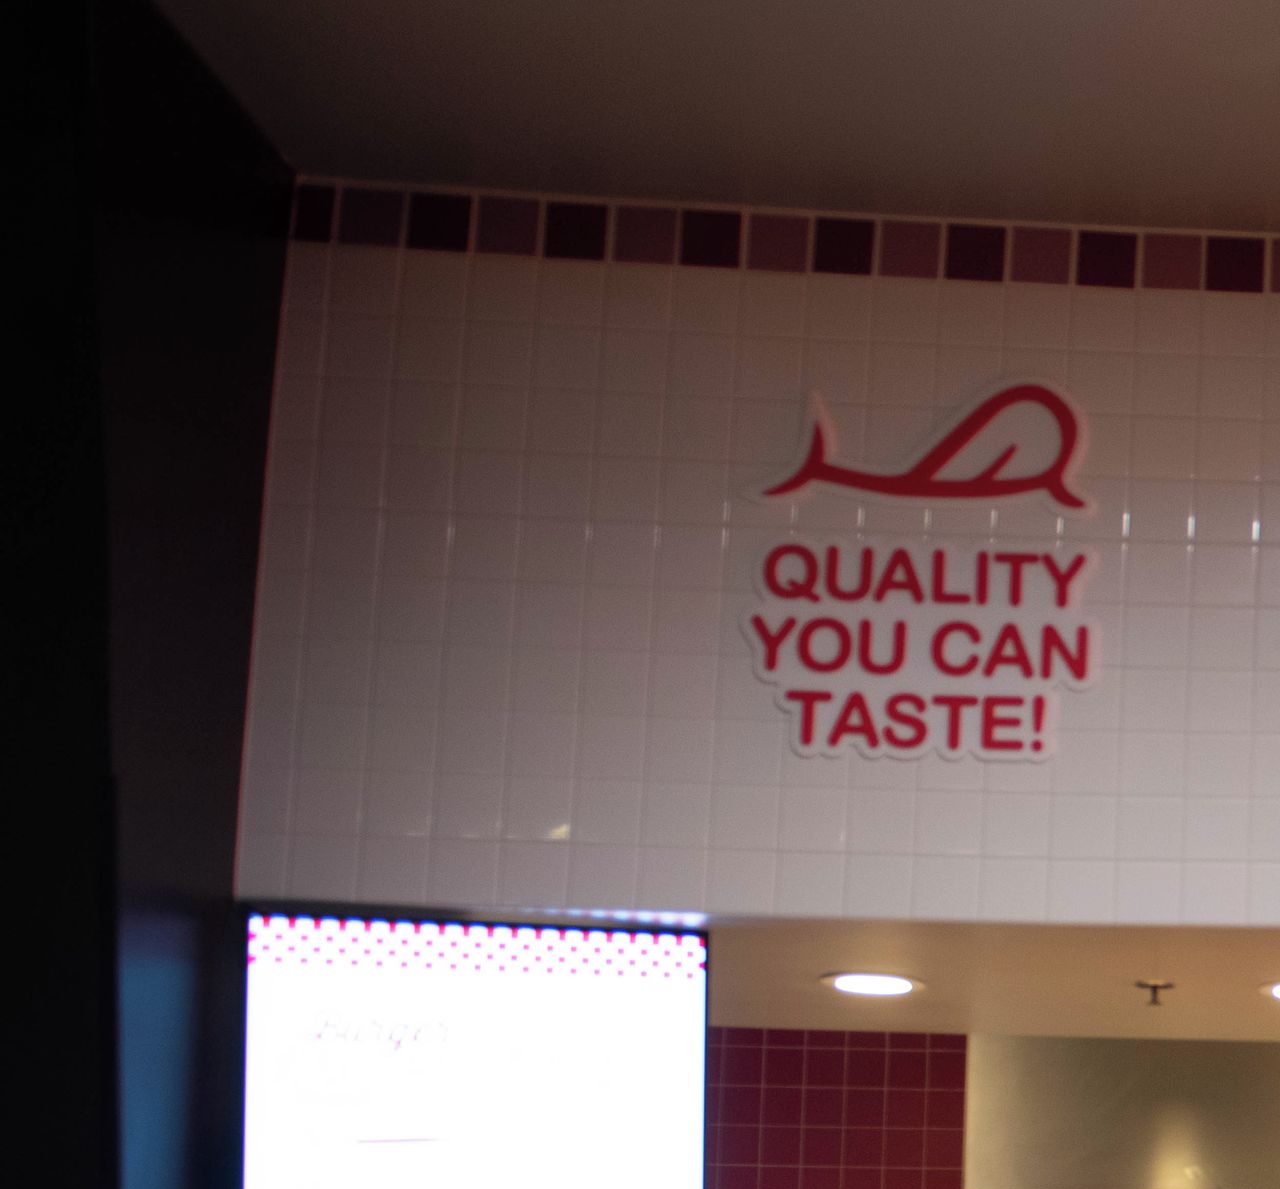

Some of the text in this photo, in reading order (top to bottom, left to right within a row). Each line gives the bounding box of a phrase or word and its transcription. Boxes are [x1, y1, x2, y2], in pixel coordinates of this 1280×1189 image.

[763, 544, 1086, 608] QUALITY
[752, 614, 1089, 680] YOU CAN
[786, 690, 1046, 752] TASTE!
